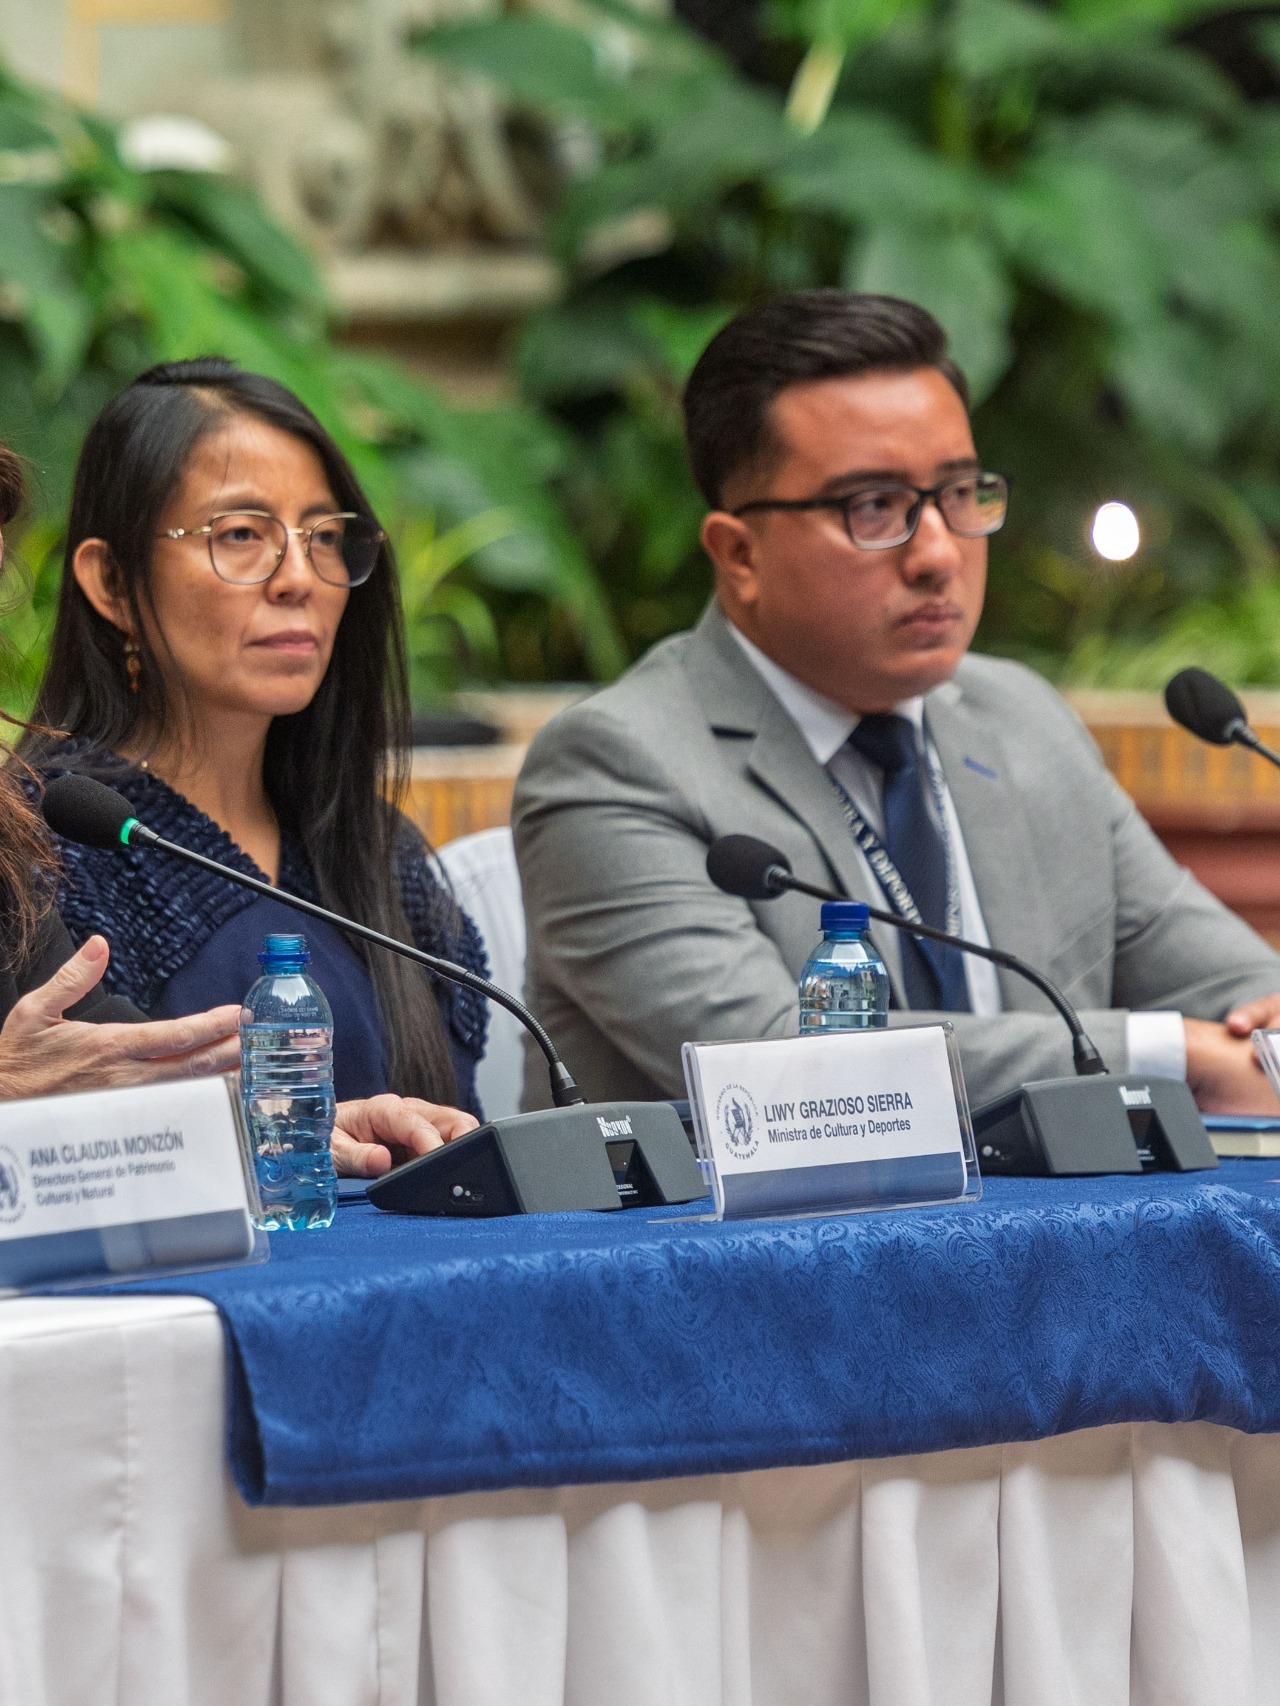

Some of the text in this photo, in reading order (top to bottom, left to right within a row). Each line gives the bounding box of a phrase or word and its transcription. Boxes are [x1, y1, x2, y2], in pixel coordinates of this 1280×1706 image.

[764, 1091, 914, 1123] LIWY GRAZIOSO SIERRA
[767, 1117, 912, 1144] Ministra de Cultura y Deportes
[29, 1147, 60, 1169] ANA
[61, 1138, 121, 1165] CLAUDIA
[124, 1127, 185, 1156] MONZÓN
[725, 1140, 760, 1161] GUATEMALA
[32, 1158, 176, 1189] Directora General de Patrimonio
[35, 1189, 73, 1207] Cultural
[81, 1184, 116, 1201] Natural
